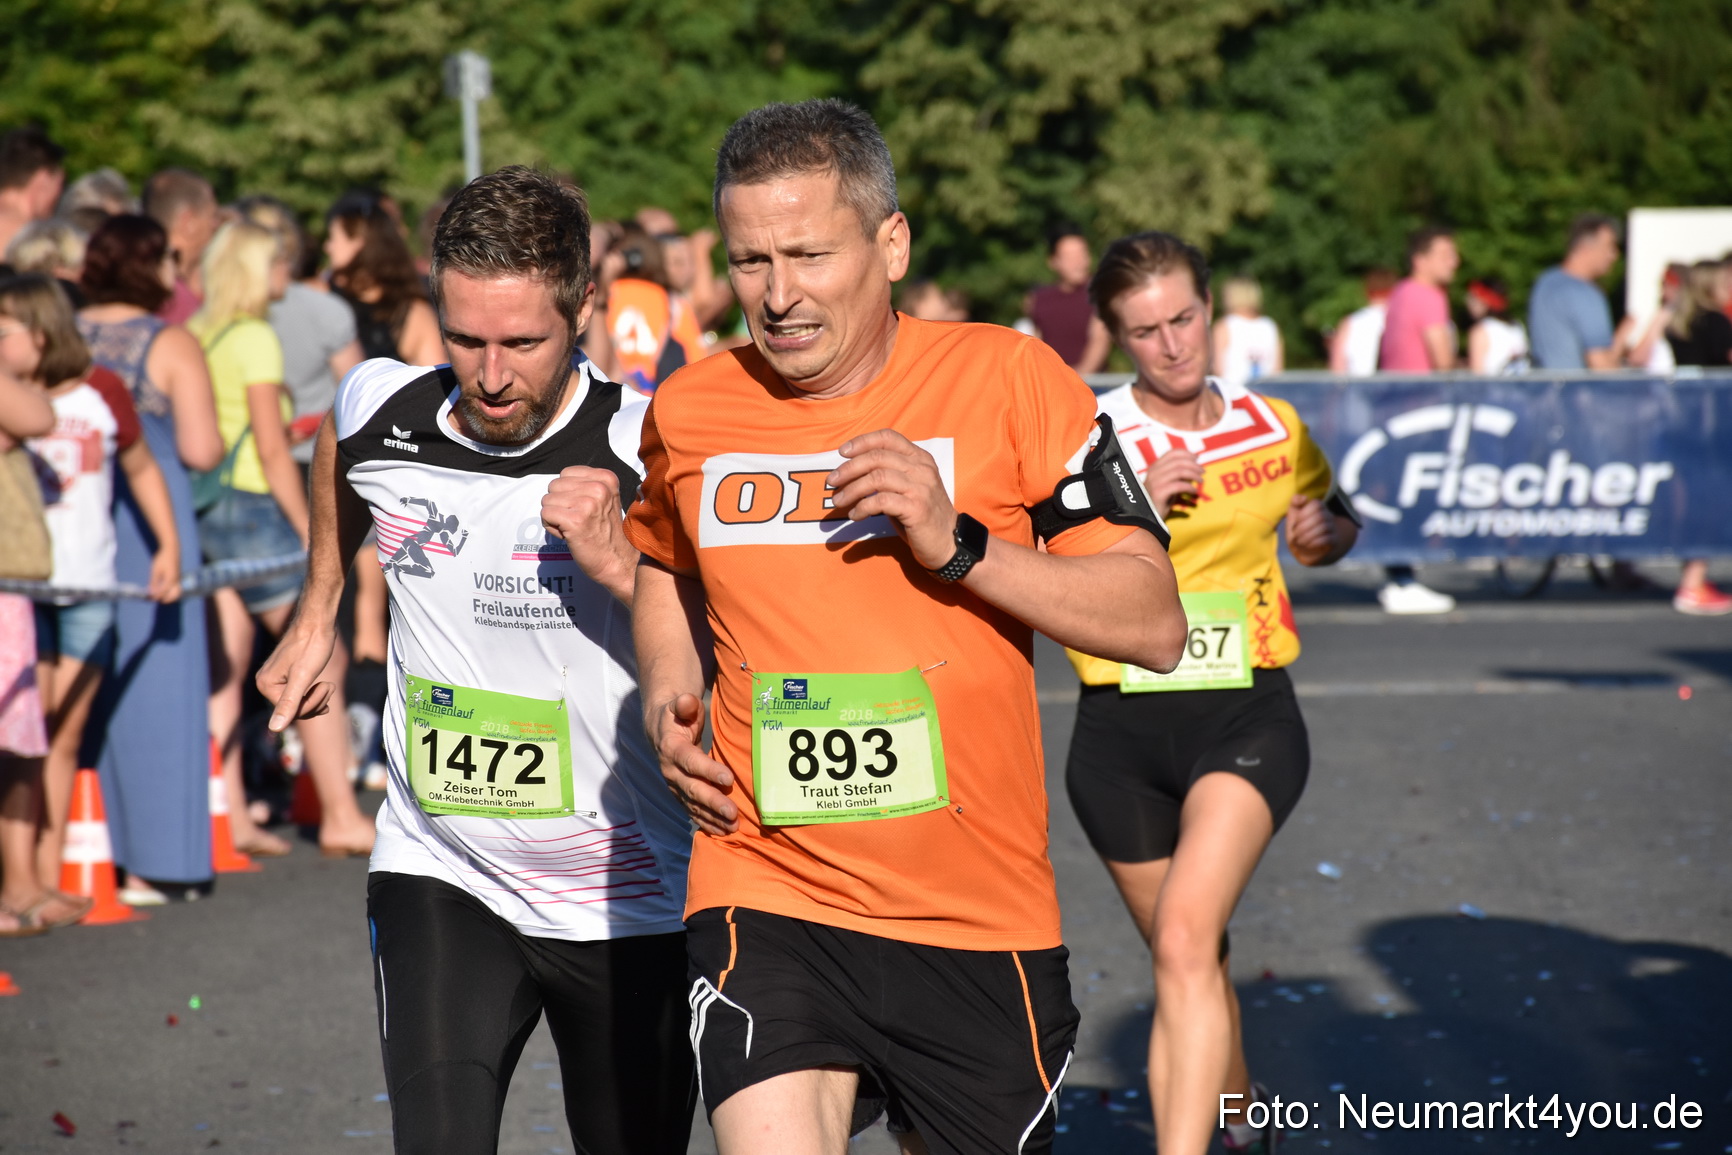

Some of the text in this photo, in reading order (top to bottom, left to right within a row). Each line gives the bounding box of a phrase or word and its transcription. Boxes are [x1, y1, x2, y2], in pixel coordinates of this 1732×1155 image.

[383, 437, 419, 453] erima
[1112, 461, 1137, 504] runtastic
[1398, 448, 1674, 508] Fischer
[713, 469, 886, 525] OB
[1421, 508, 1651, 538] AUTOMOBILE
[473, 572, 574, 594] VORSICHT!
[473, 598, 576, 618] Freilaufende
[474, 616, 578, 631] Klebebandspezialisten
[1187, 626, 1231, 659] 67
[422, 699, 475, 720] firmenlauf
[773, 697, 832, 711] firmenlauf
[839, 709, 873, 721] 2018
[480, 720, 510, 734] 2018
[422, 729, 546, 785] 1472
[788, 728, 898, 781] 893
[443, 780, 518, 798] Zeiser Tom
[800, 782, 892, 798] Traut Stefan
[428, 791, 535, 808] OM-Klebetechnik GmbH
[816, 798, 877, 809] Klebl GmbH
